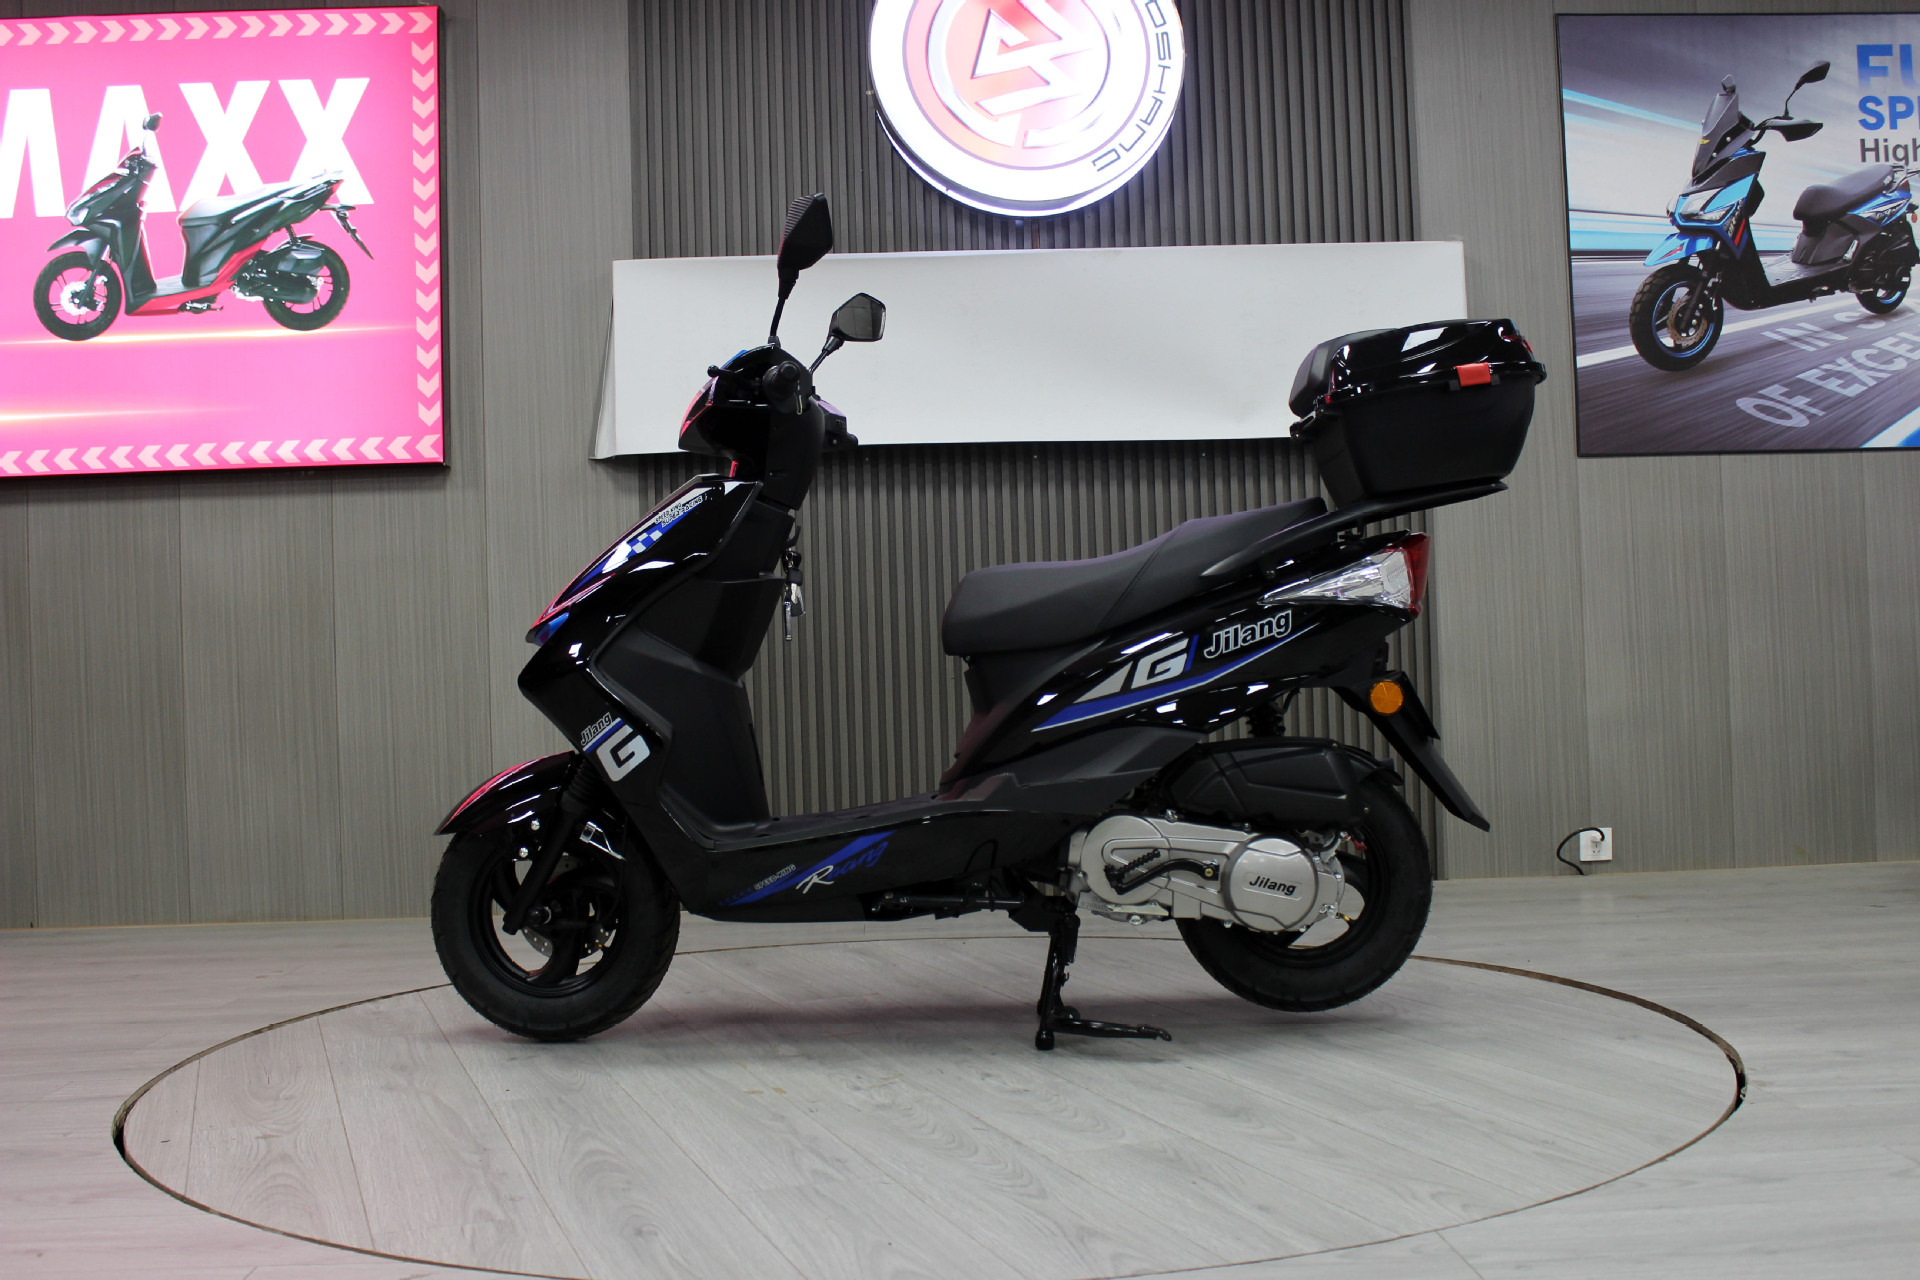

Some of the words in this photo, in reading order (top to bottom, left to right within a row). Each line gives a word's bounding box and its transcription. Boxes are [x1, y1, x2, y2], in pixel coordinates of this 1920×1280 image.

[1858, 95, 1920, 130] SP
[1760, 322, 1848, 352] IN
[1735, 383, 1826, 428] OF
[1203, 609, 1292, 659] Jilang
[580, 712, 613, 745] Jilang
[596, 724, 651, 782] G
[1249, 876, 1297, 896] Jilang
